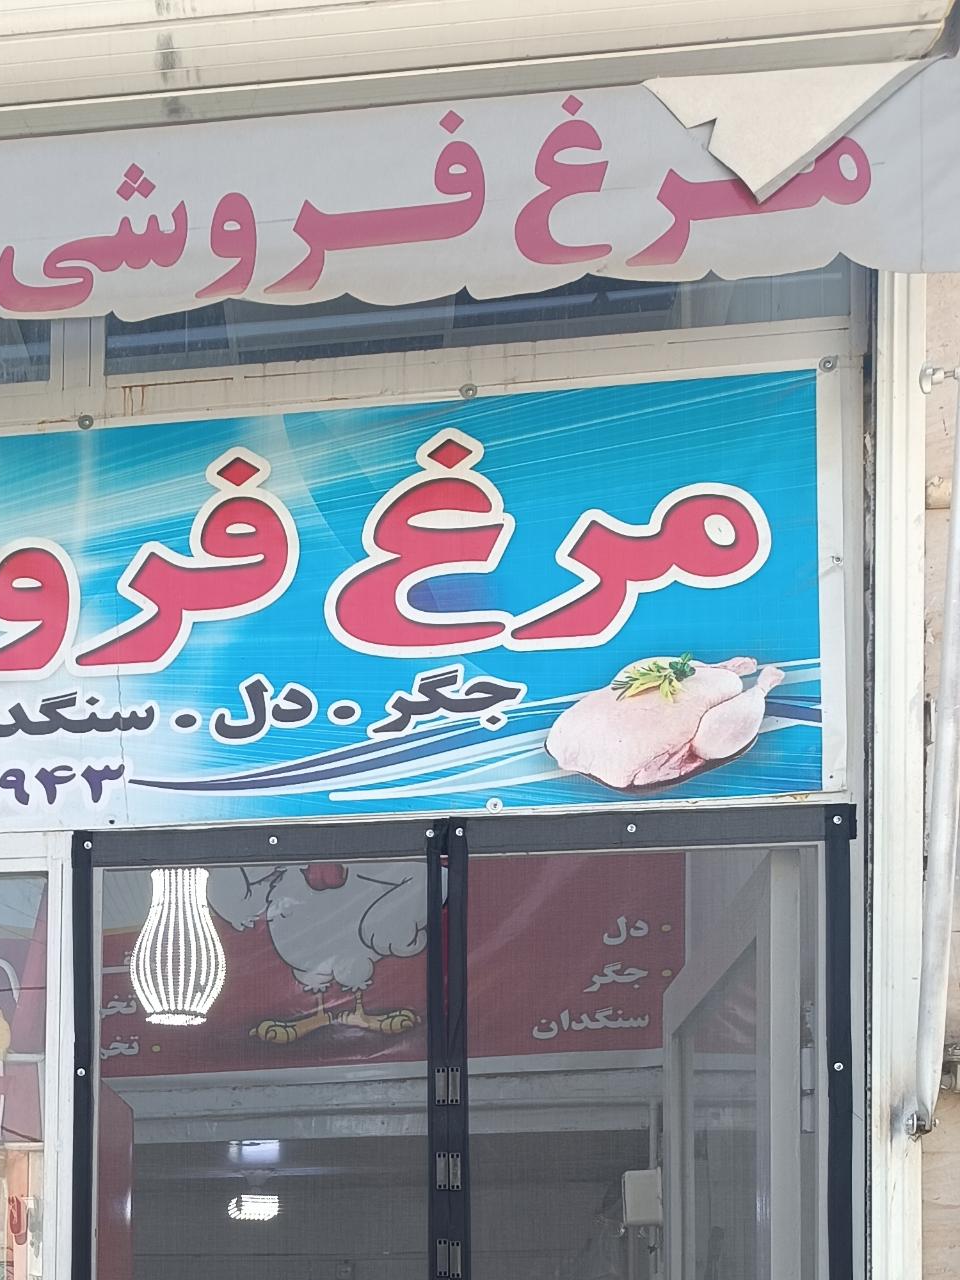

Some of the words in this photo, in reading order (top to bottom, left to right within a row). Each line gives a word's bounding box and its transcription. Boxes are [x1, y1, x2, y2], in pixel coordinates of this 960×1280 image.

[514, 95, 872, 268] مرغ
[333, 436, 761, 648] مرغ
[214, 677, 314, 740] دل
[371, 668, 522, 734] جگر
[602, 915, 650, 946] دل
[583, 960, 650, 994] جگر
[532, 1006, 650, 1040] سنگدان
